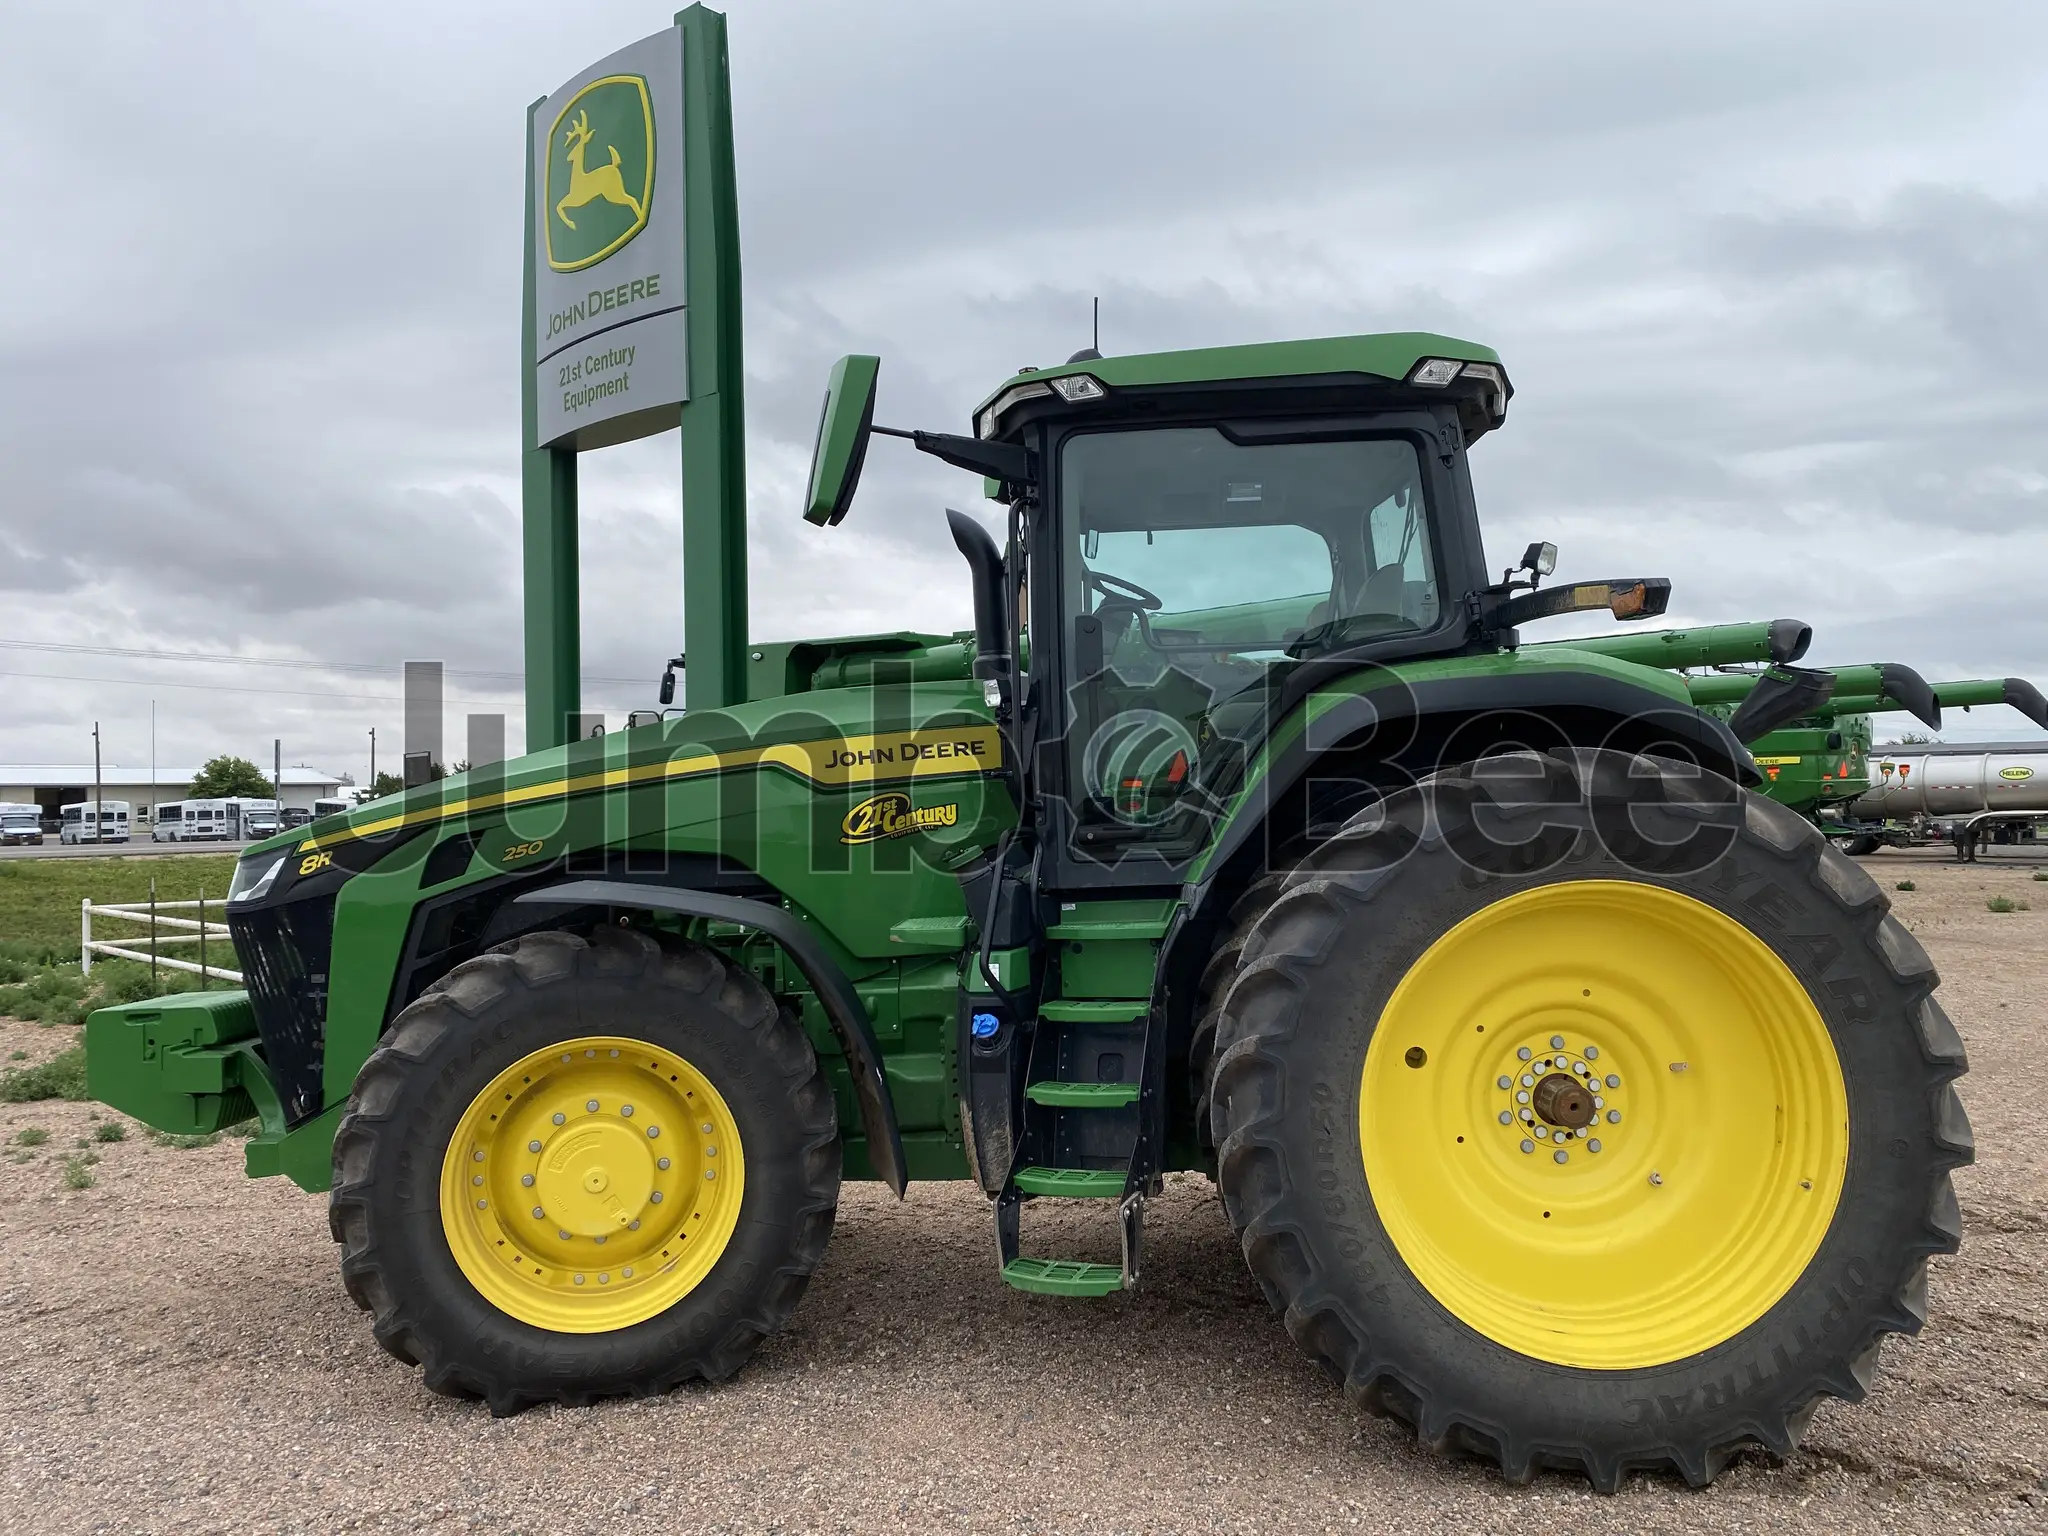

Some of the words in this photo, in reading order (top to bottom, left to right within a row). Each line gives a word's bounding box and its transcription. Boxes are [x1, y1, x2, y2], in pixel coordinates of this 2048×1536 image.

[546, 301, 585, 341] JOHN
[588, 273, 660, 318] DEERE
[559, 361, 582, 388] 21st
[585, 345, 636, 376] Century
[563, 372, 629, 413] Equipment
[825, 747, 894, 769] JOHN
[900, 740, 986, 762] DEERE
[854, 798, 898, 836] 21st
[298, 850, 333, 876] 8R
[501, 839, 544, 862] 250
[1620, 1254, 1869, 1430] OPTITRAC
